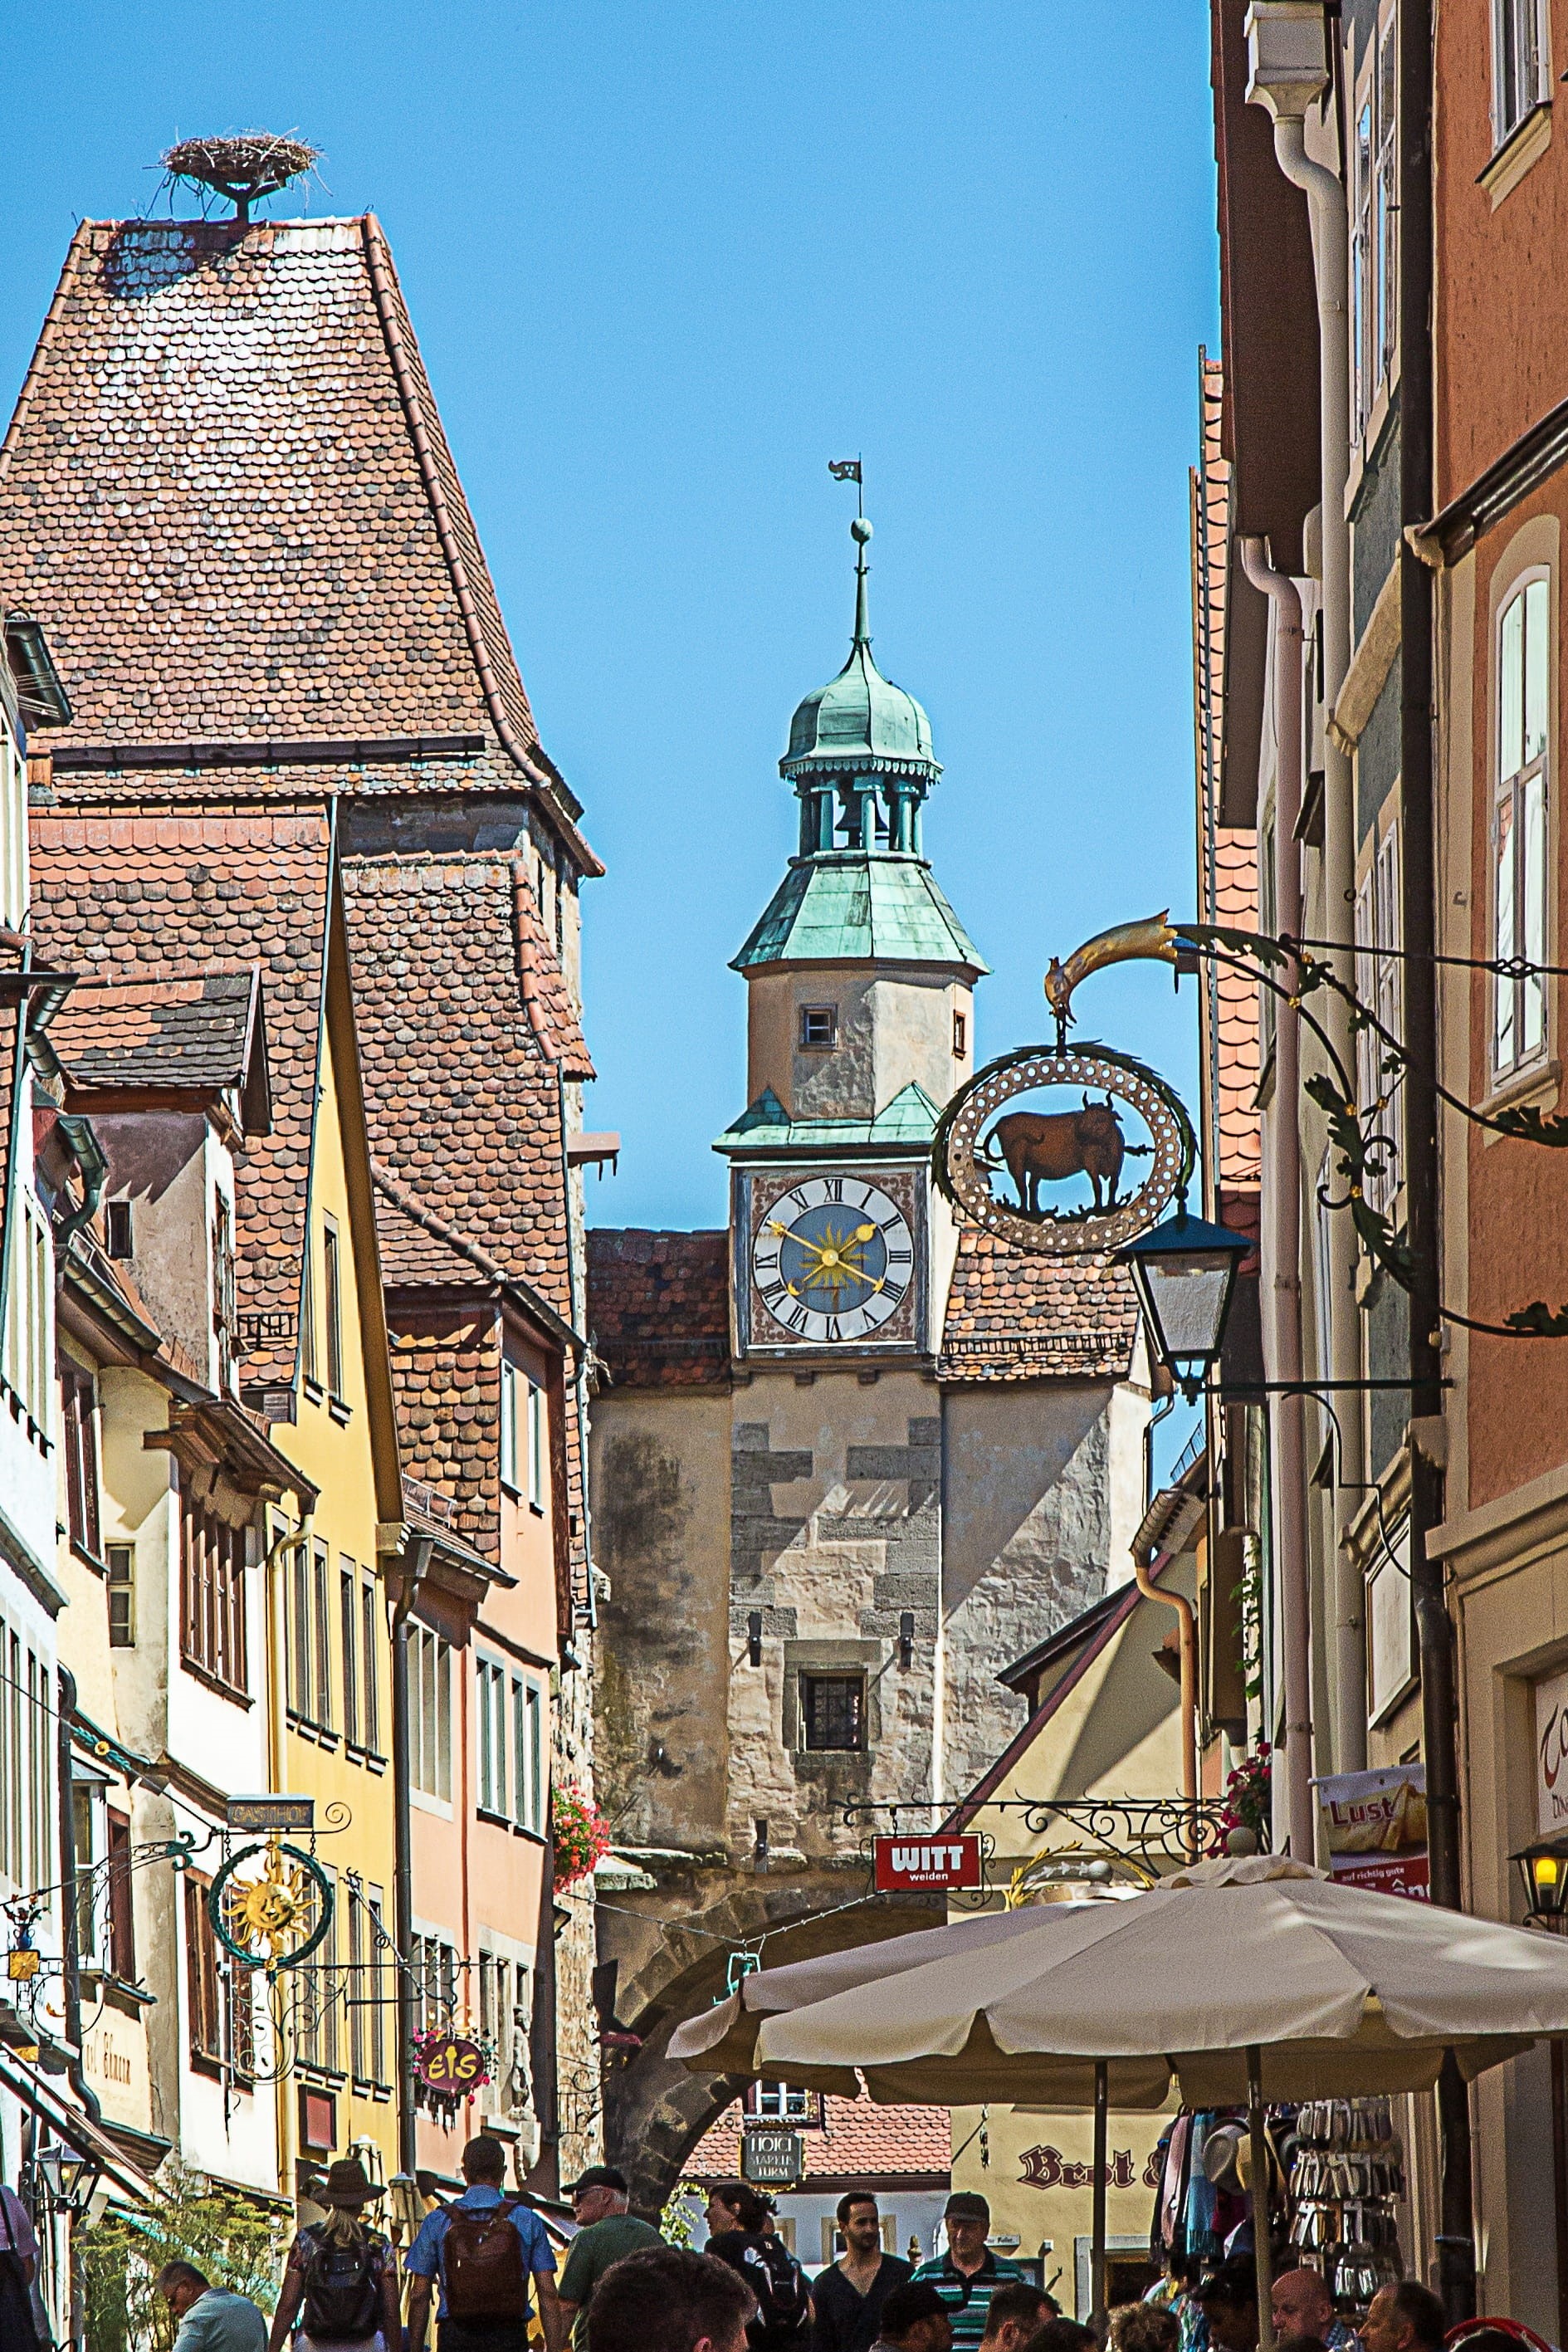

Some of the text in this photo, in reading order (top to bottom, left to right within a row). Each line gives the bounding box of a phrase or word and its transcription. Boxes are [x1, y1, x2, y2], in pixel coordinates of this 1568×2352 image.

[789, 1187, 811, 1215] XI
[823, 1179, 843, 1202] XII
[858, 1187, 875, 1210] I
[881, 1212, 903, 1233] II
[755, 1253, 778, 1270] IX
[888, 1249, 911, 1264] III
[786, 1304, 809, 1333] VII
[825, 1315, 843, 1340] VI
[862, 1308, 881, 1329] V
[232, 1805, 312, 1823] GASTHOF
[1330, 1797, 1394, 1826] Lust
[891, 1846, 964, 1872] WITT
[909, 1871, 949, 1882] weiden
[1016, 2144, 1137, 2190] Brot
